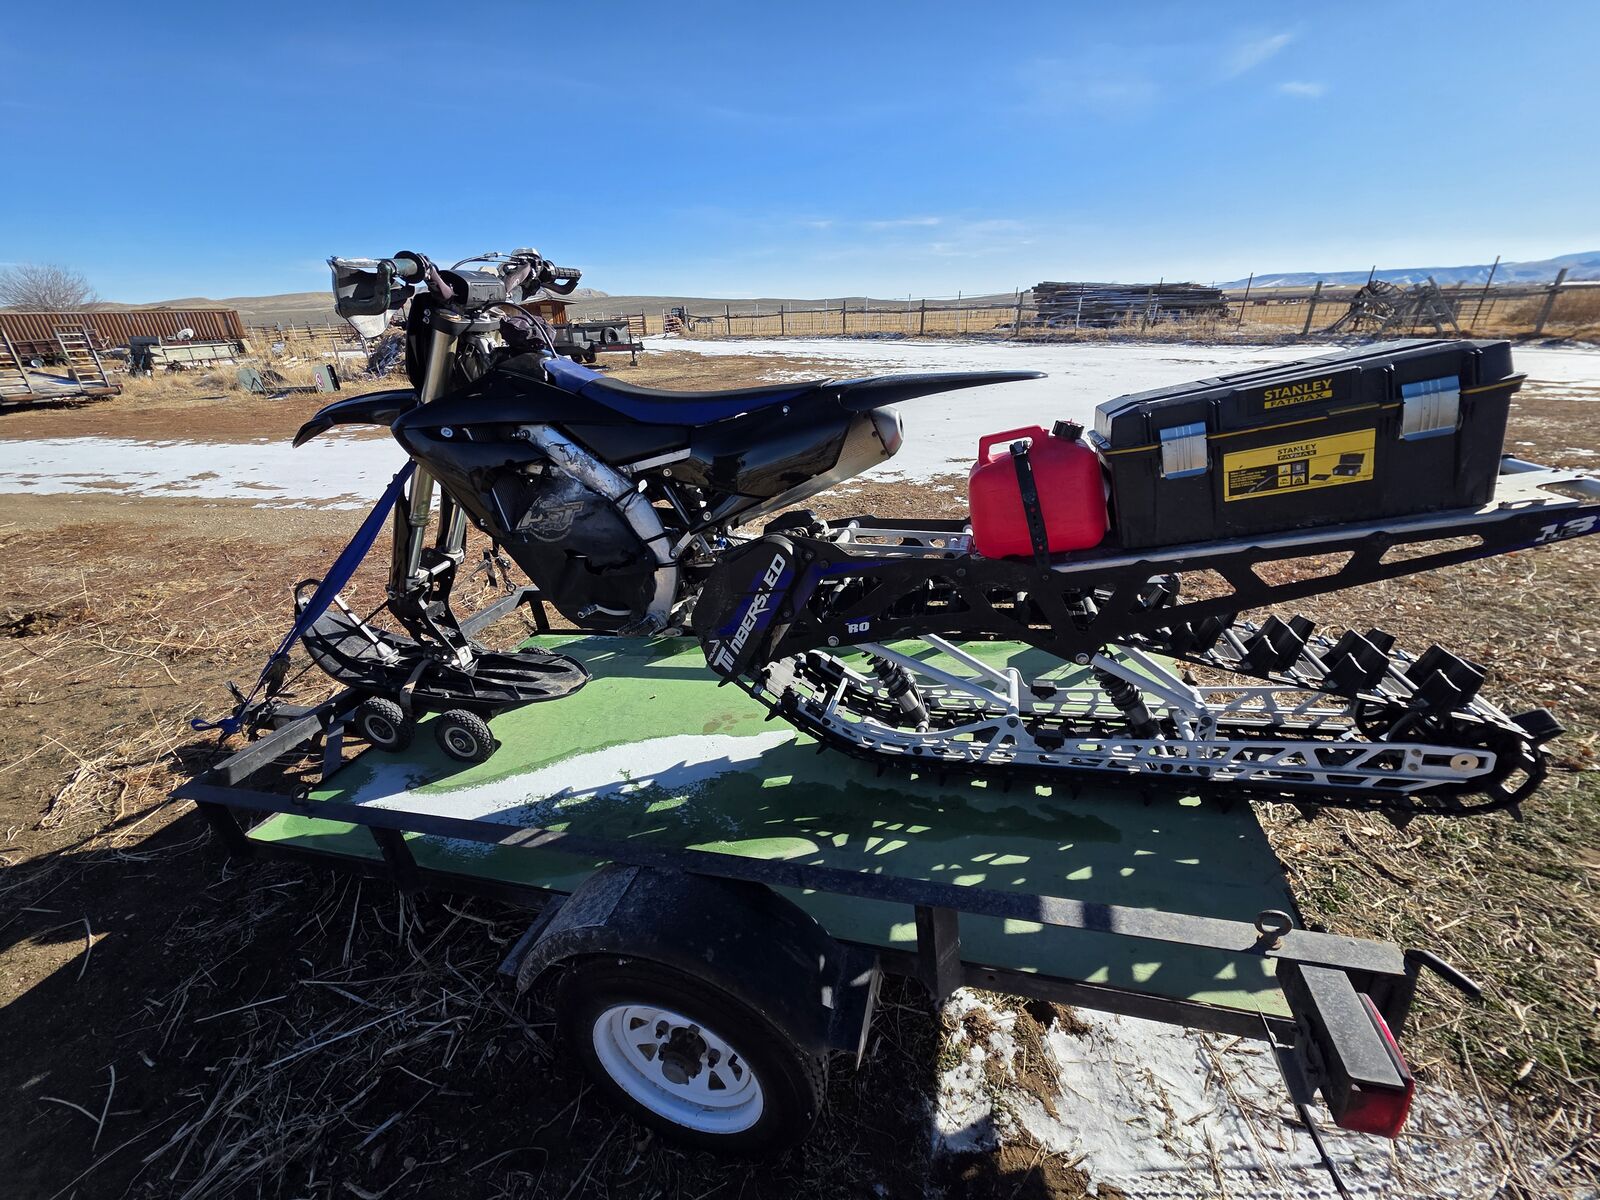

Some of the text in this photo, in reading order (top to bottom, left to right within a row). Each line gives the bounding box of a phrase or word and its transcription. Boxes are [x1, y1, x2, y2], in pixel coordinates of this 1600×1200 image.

[1264, 379, 1332, 400] STANLEY
[1270, 391, 1324, 407] FATMAX
[1278, 444, 1316, 455] STANLEY
[713, 553, 785, 672] TIMBERSED
[844, 621, 870, 634] RO
